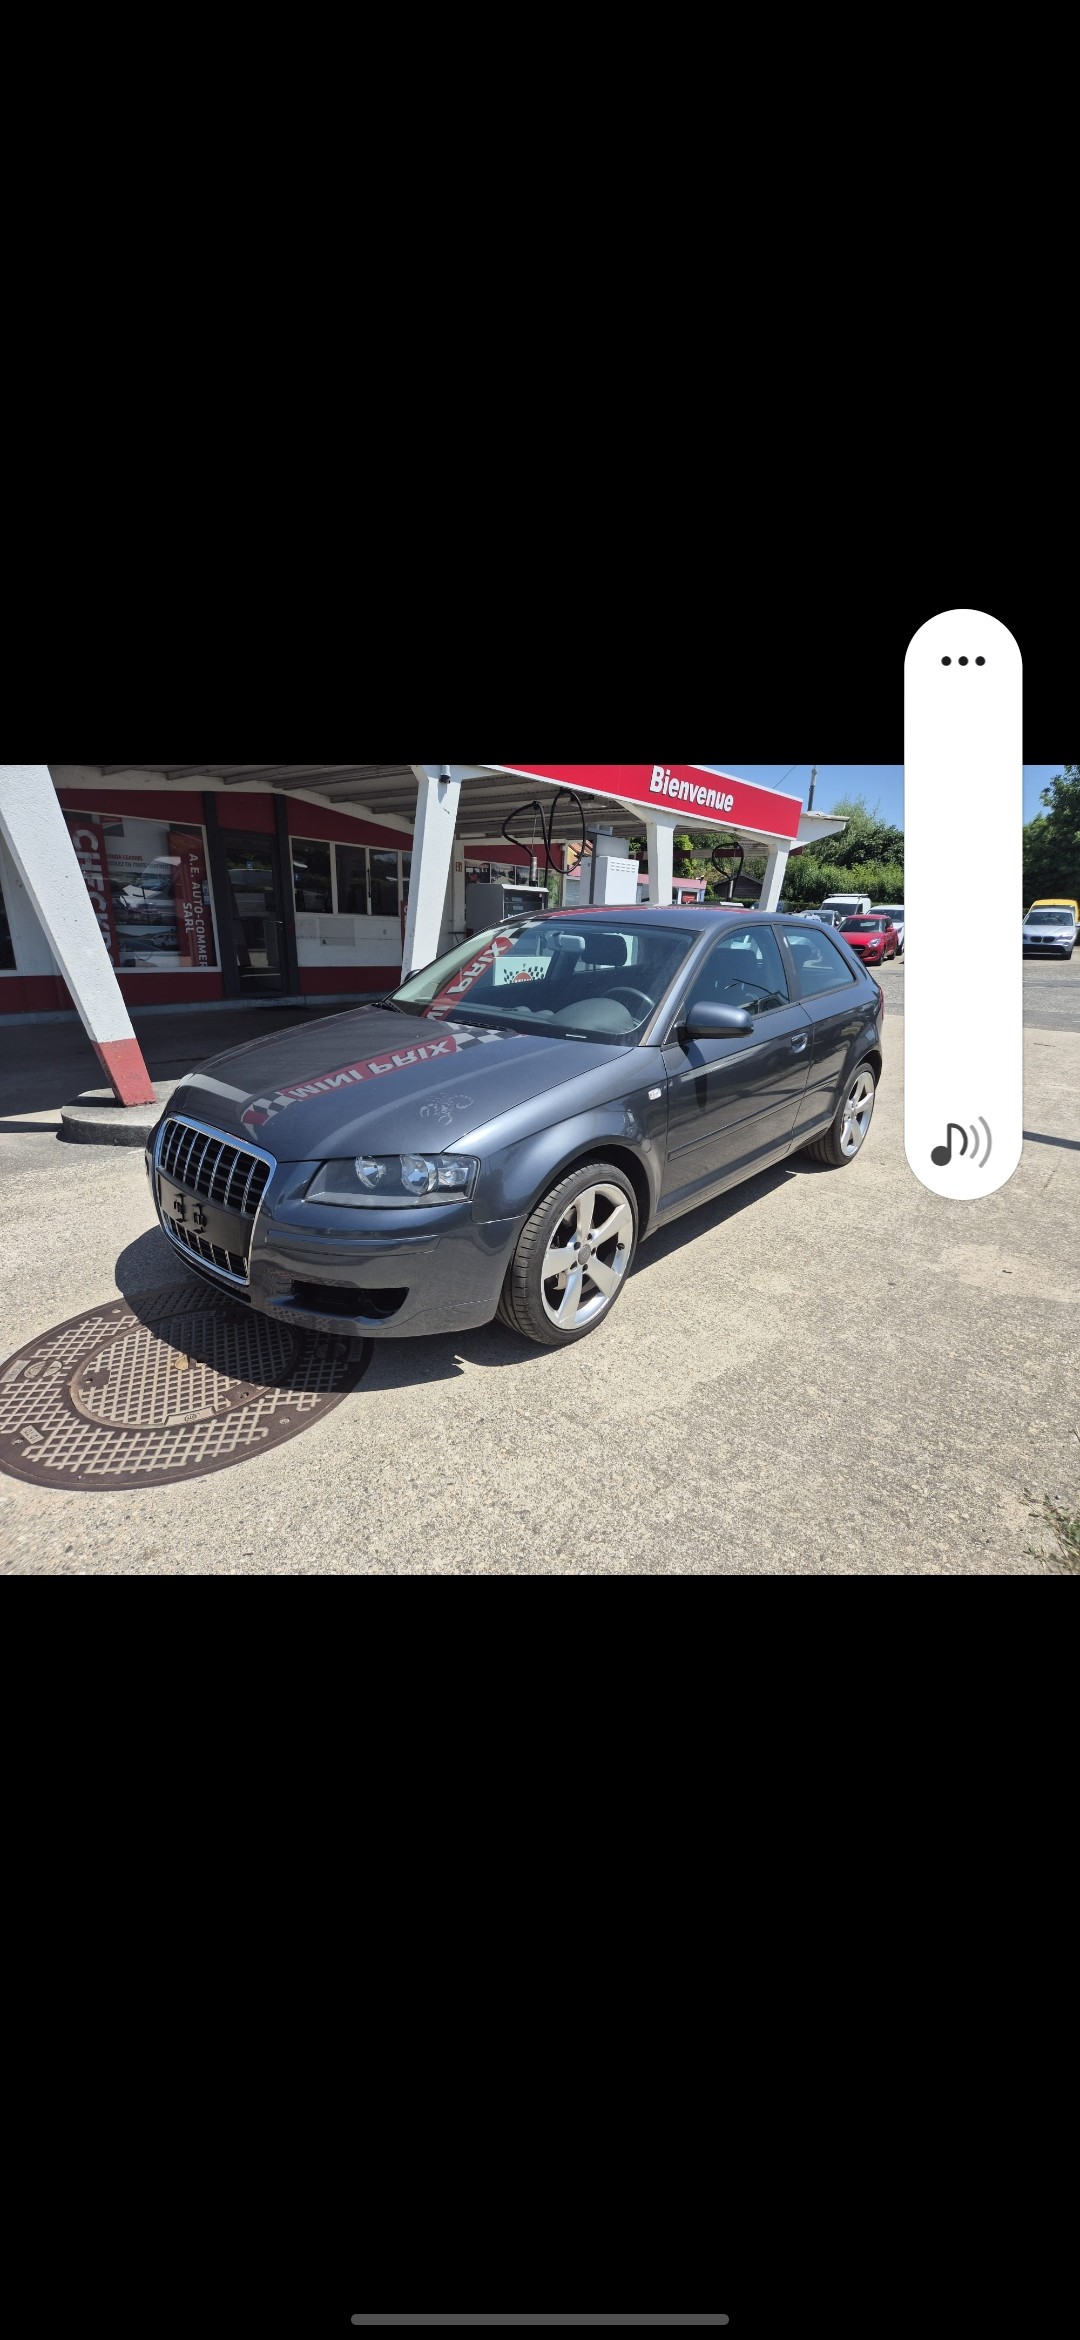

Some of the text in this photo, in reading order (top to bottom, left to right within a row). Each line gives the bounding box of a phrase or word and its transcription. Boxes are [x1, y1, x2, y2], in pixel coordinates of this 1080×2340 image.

[649, 765, 734, 813] Bienvenue
[189, 853, 200, 878] A.E.
[182, 902, 194, 934] SARL
